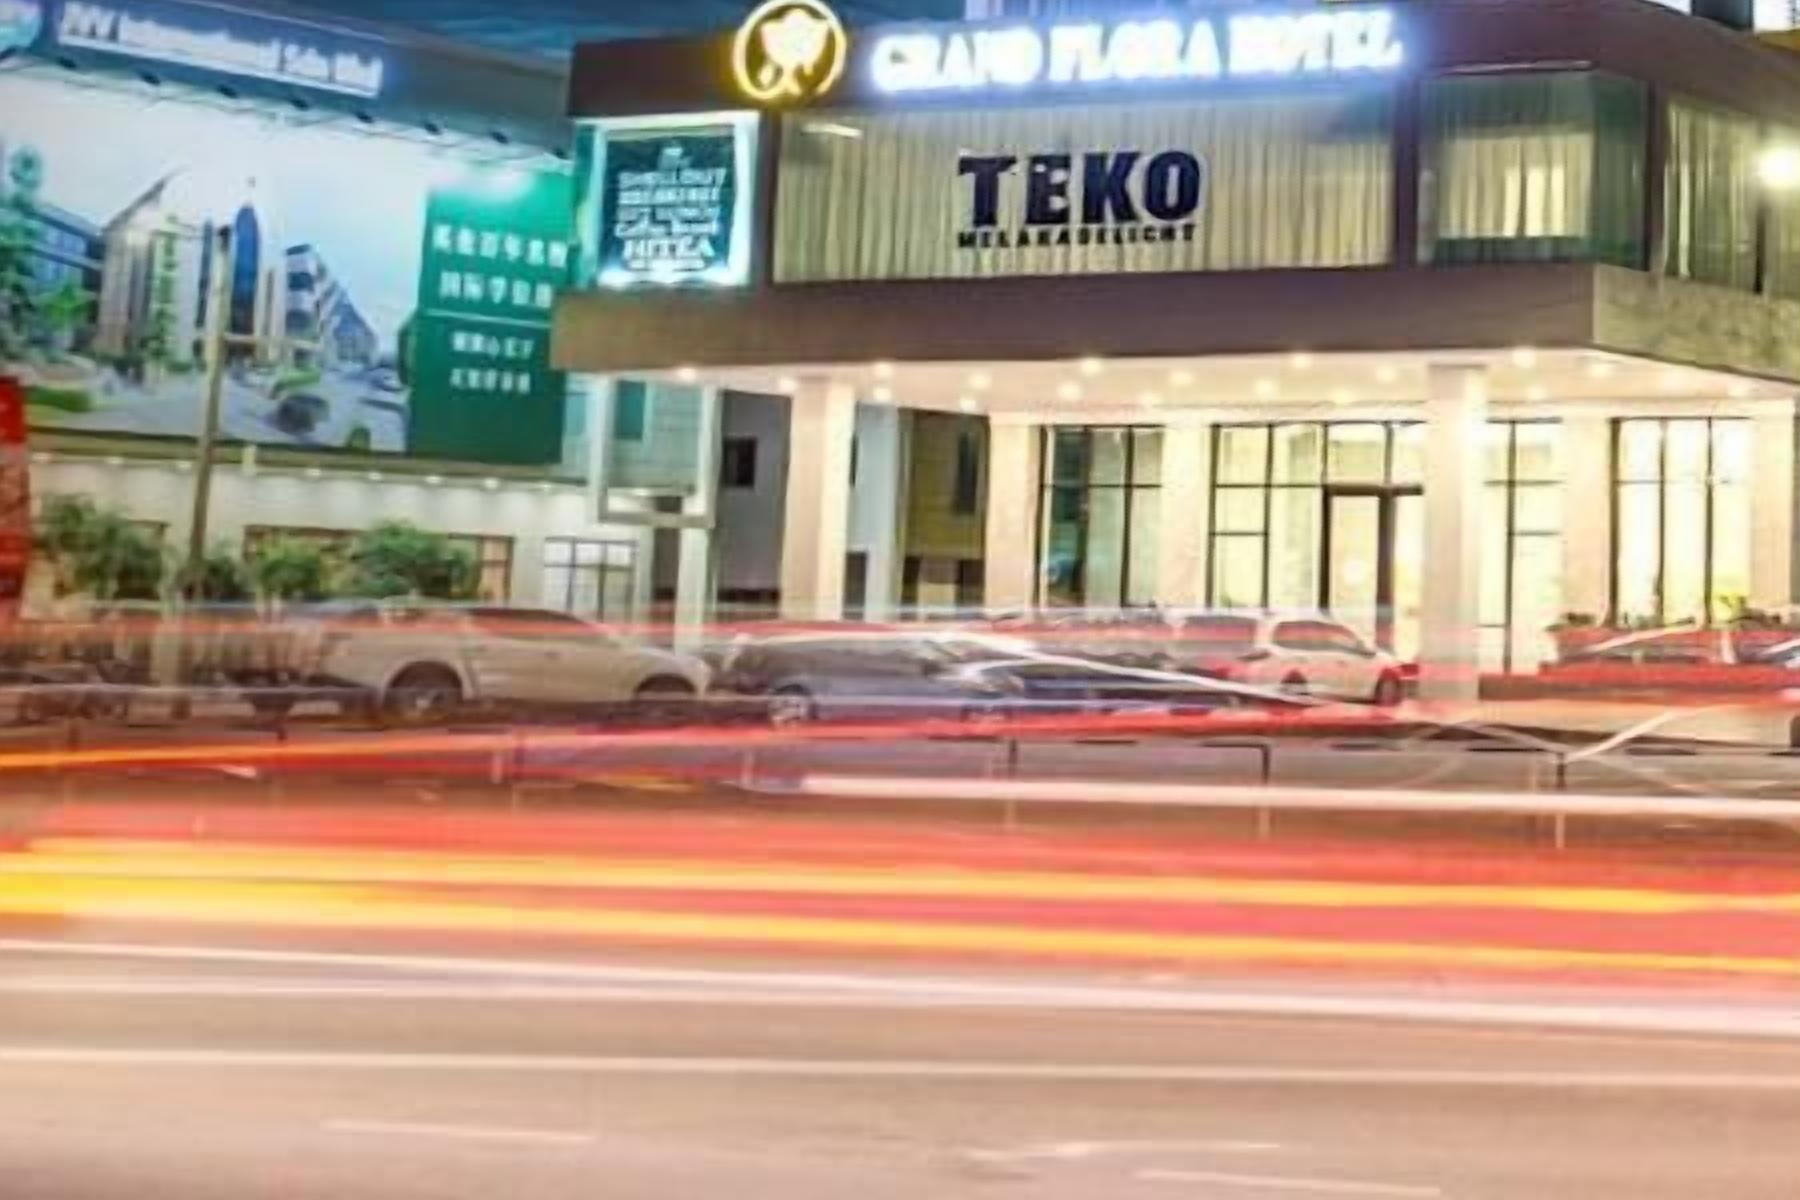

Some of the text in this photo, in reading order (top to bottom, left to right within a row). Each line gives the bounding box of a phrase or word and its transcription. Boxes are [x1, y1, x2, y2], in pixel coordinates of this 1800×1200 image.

[872, 10, 1402, 90] GRAND FLORA HOTEL
[957, 151, 1200, 227] TEKO
